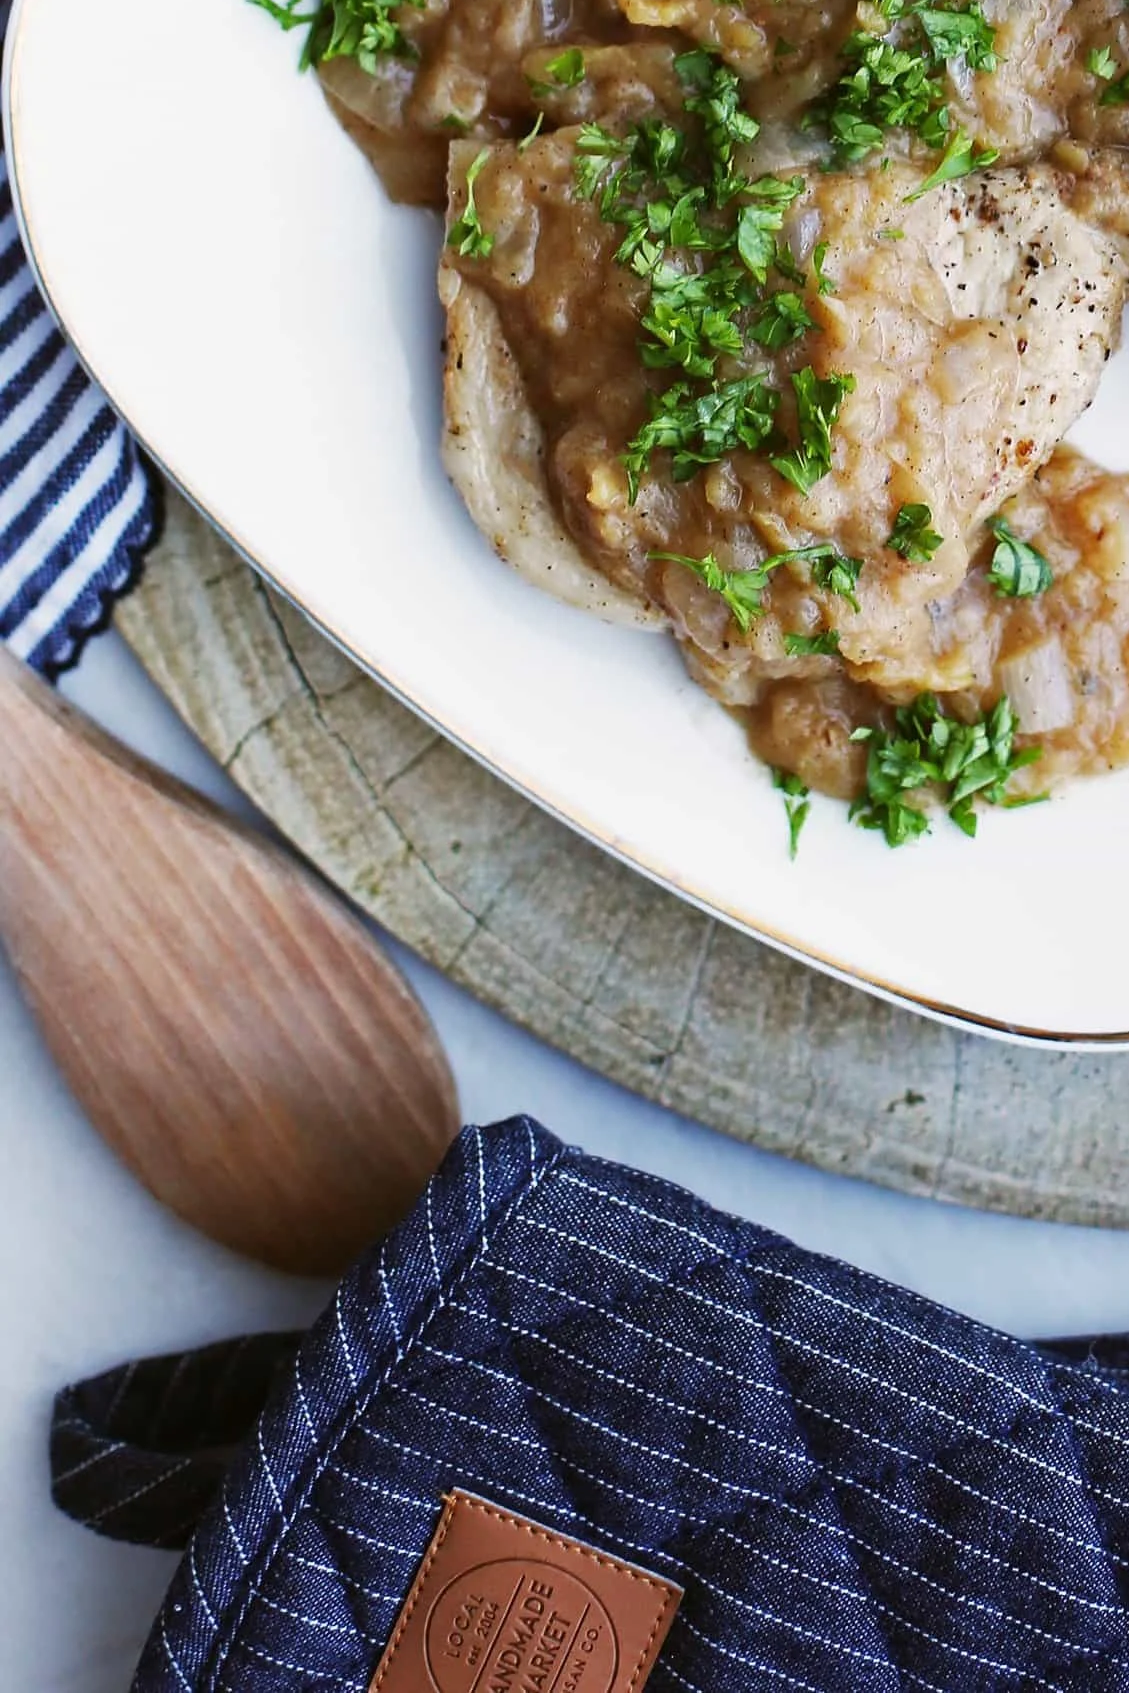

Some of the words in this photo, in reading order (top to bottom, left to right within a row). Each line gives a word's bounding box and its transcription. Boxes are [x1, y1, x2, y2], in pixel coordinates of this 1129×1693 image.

[444, 1594, 484, 1658] LOCAL
[475, 1602, 499, 1639] 2004
[489, 1580, 553, 1693] ANDMADE
[581, 1626, 602, 1653] CO.
